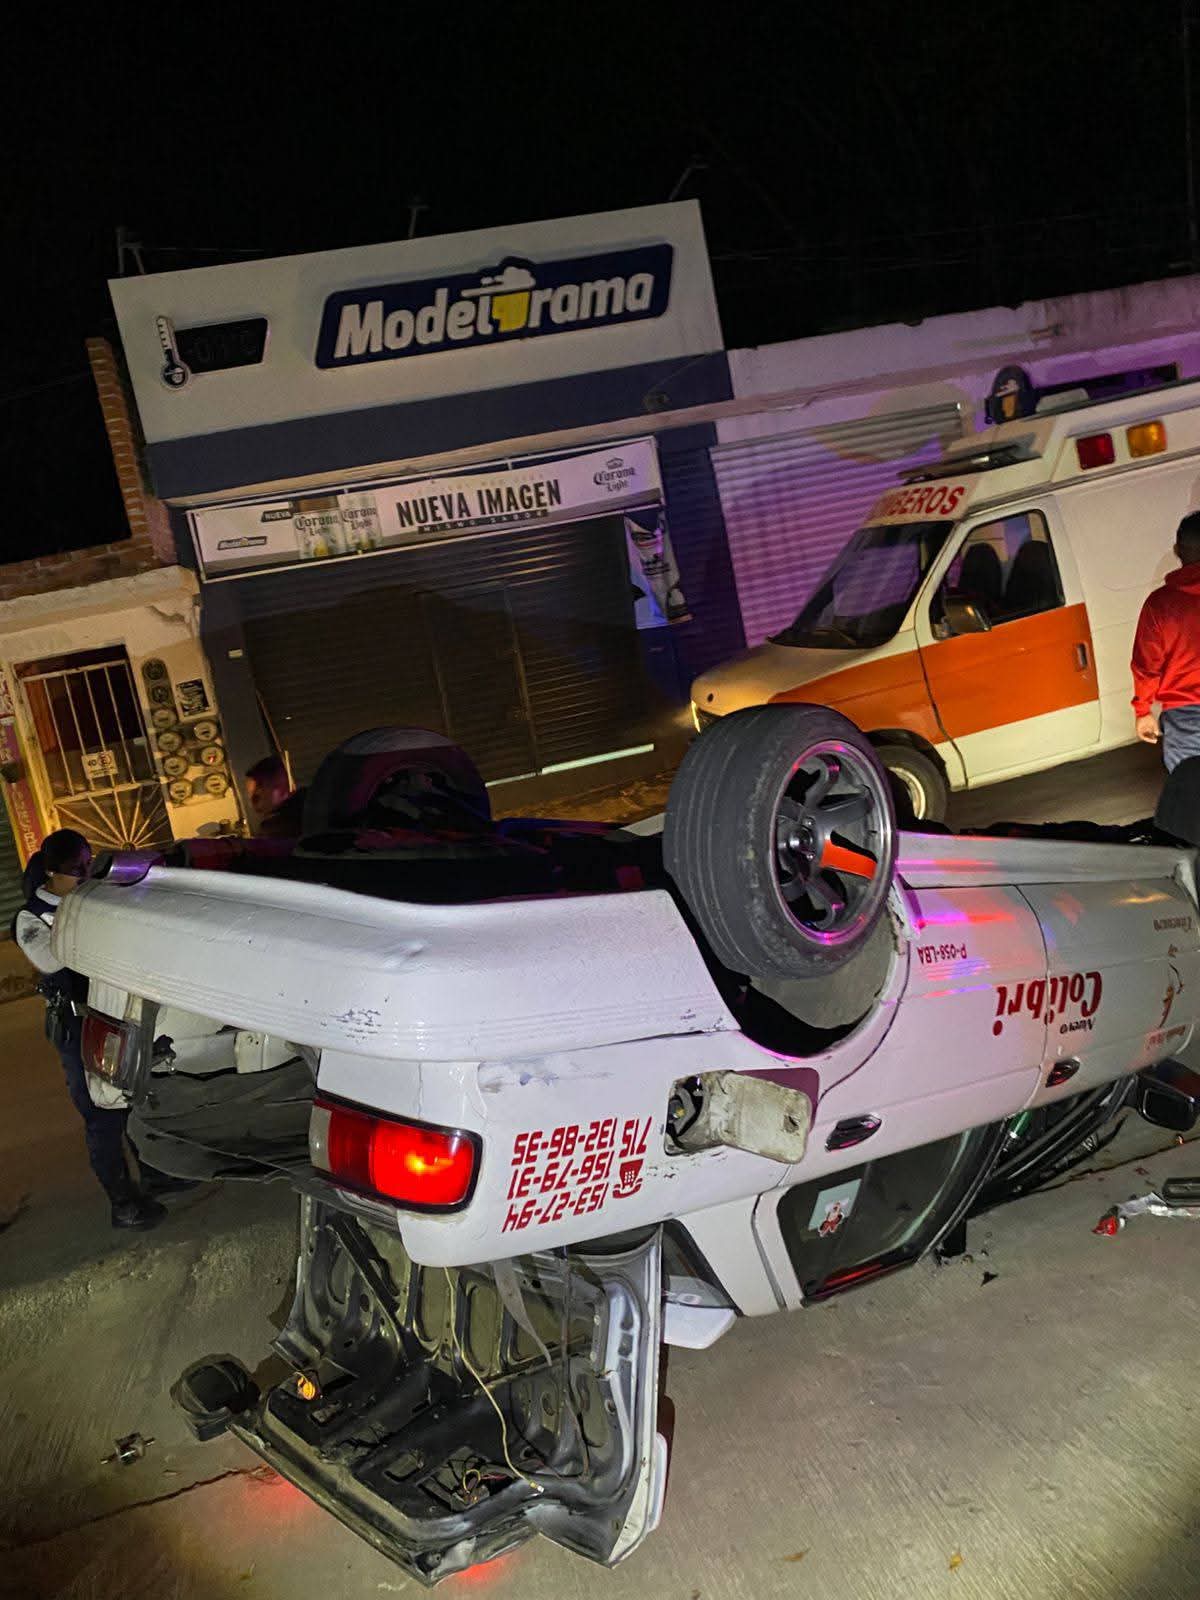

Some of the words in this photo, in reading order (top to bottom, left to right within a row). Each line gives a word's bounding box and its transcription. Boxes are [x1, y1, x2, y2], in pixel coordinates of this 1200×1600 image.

[395, 491, 471, 528] NUEVA
[477, 479, 562, 516] IMAGEN
[992, 970, 1103, 1036] Colibri
[1059, 1017, 1097, 1035] Nuevo
[511, 1117, 618, 1167] 132-86-35
[618, 1116, 653, 1159] 715
[507, 1151, 615, 1200] 156-79-31
[501, 1183, 609, 1233] 153-27-94
